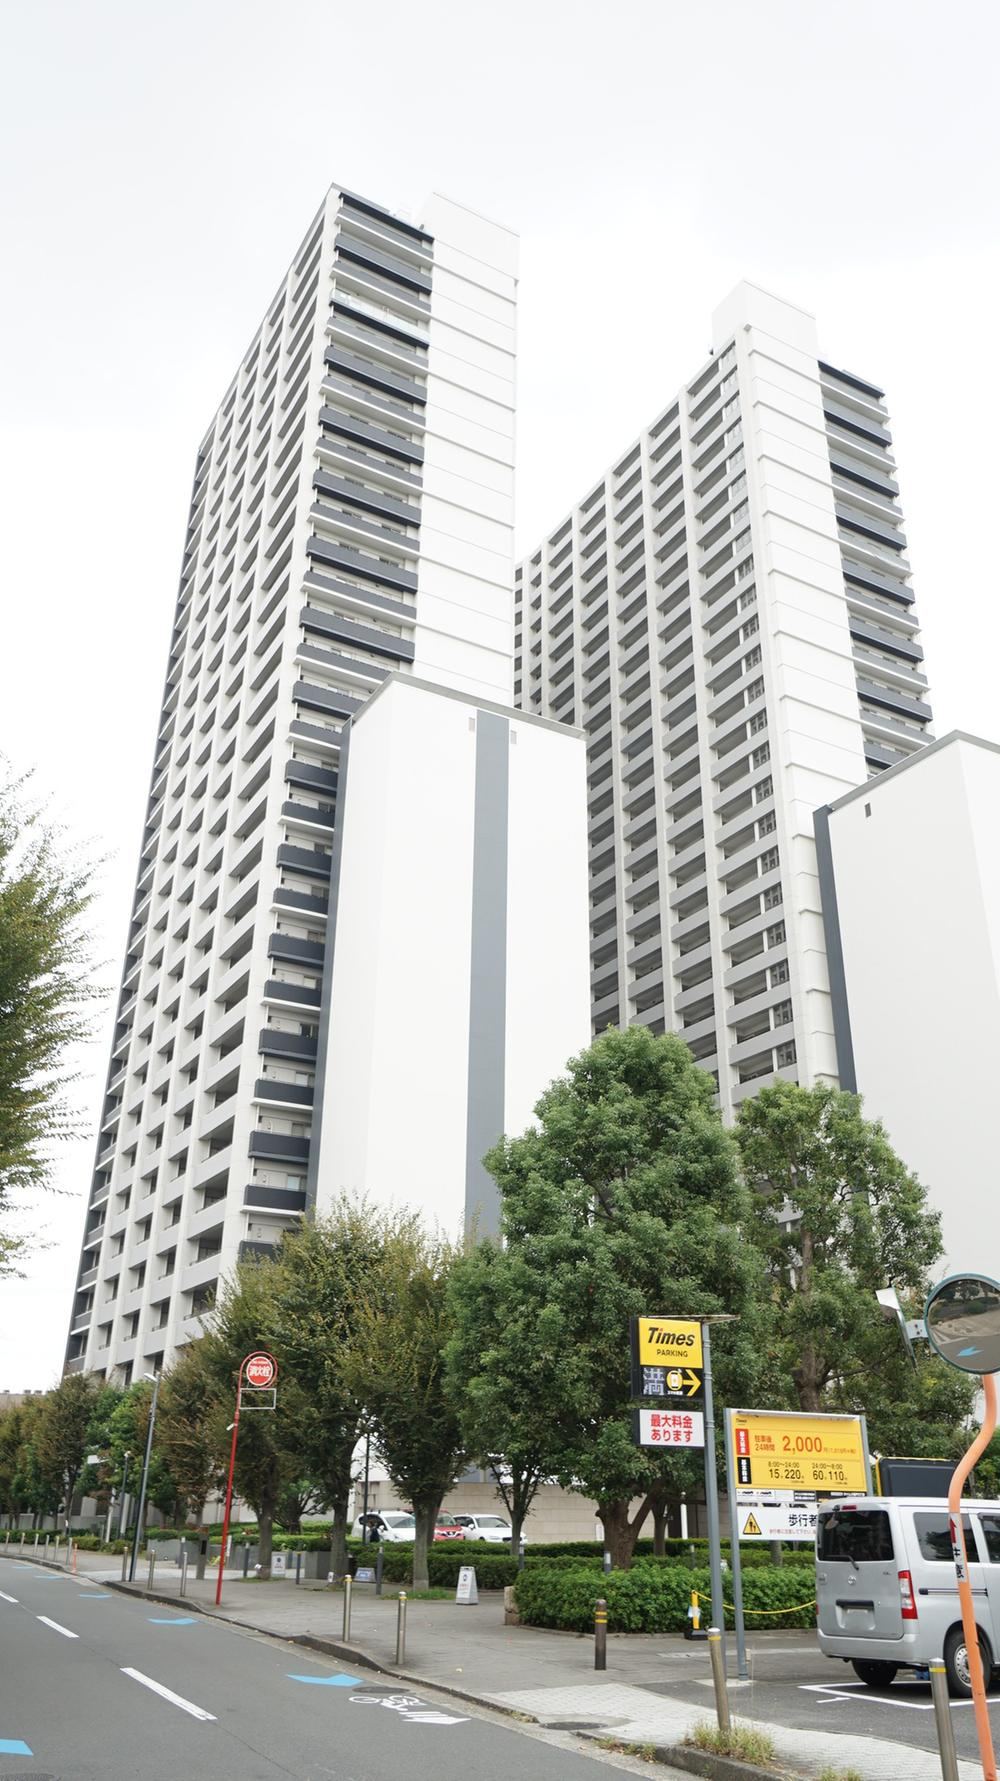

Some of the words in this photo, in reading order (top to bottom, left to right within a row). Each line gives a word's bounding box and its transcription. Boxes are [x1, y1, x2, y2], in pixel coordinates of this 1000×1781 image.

[647, 1326, 695, 1346] Times
[656, 1348, 689, 1358] PARKING
[650, 1413, 693, 1429] 最大料金
[650, 1429, 693, 1442] あります
[782, 1435, 823, 1455] 2,000
[788, 1513, 818, 1527] 歩行者
